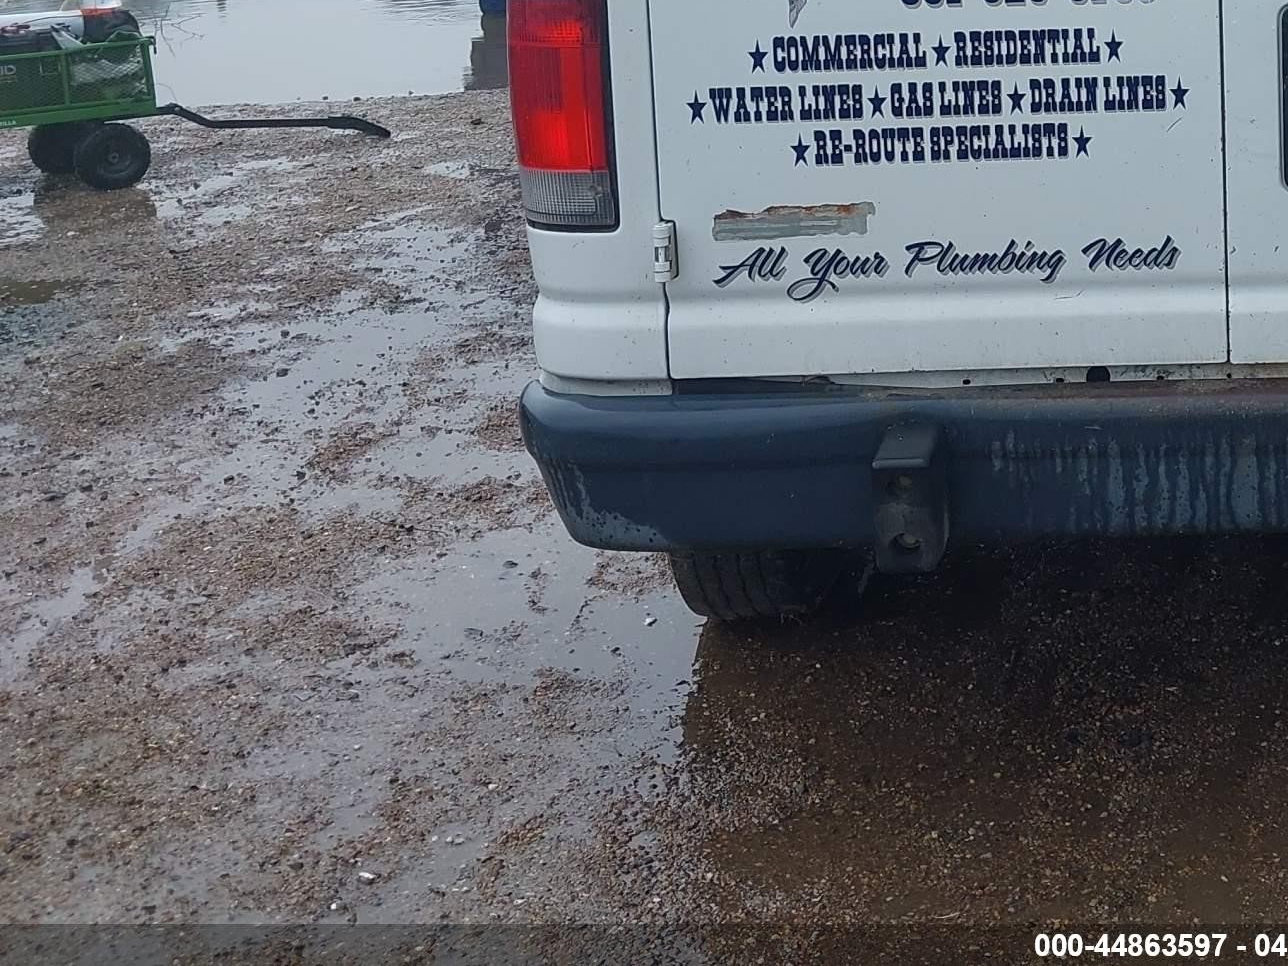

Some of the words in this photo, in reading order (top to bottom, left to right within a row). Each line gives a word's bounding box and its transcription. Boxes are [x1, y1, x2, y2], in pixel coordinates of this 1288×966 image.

[772, 32, 928, 73] COMMERCIAL
[953, 27, 1101, 68] RESIDENTIAL
[708, 85, 796, 124] WATER
[798, 83, 864, 121] LINES
[890, 81, 934, 118] GAS
[937, 79, 1003, 117] LINES
[1029, 76, 1099, 115] DRAIN
[1102, 74, 1167, 112] LINES
[813, 125, 926, 166] RE-ROUTE
[929, 122, 1070, 163] SPECIALISTS
[712, 246, 787, 286] All
[786, 248, 888, 302] Your
[904, 239, 1066, 284] Plumbing
[1080, 234, 1179, 271] Needs
